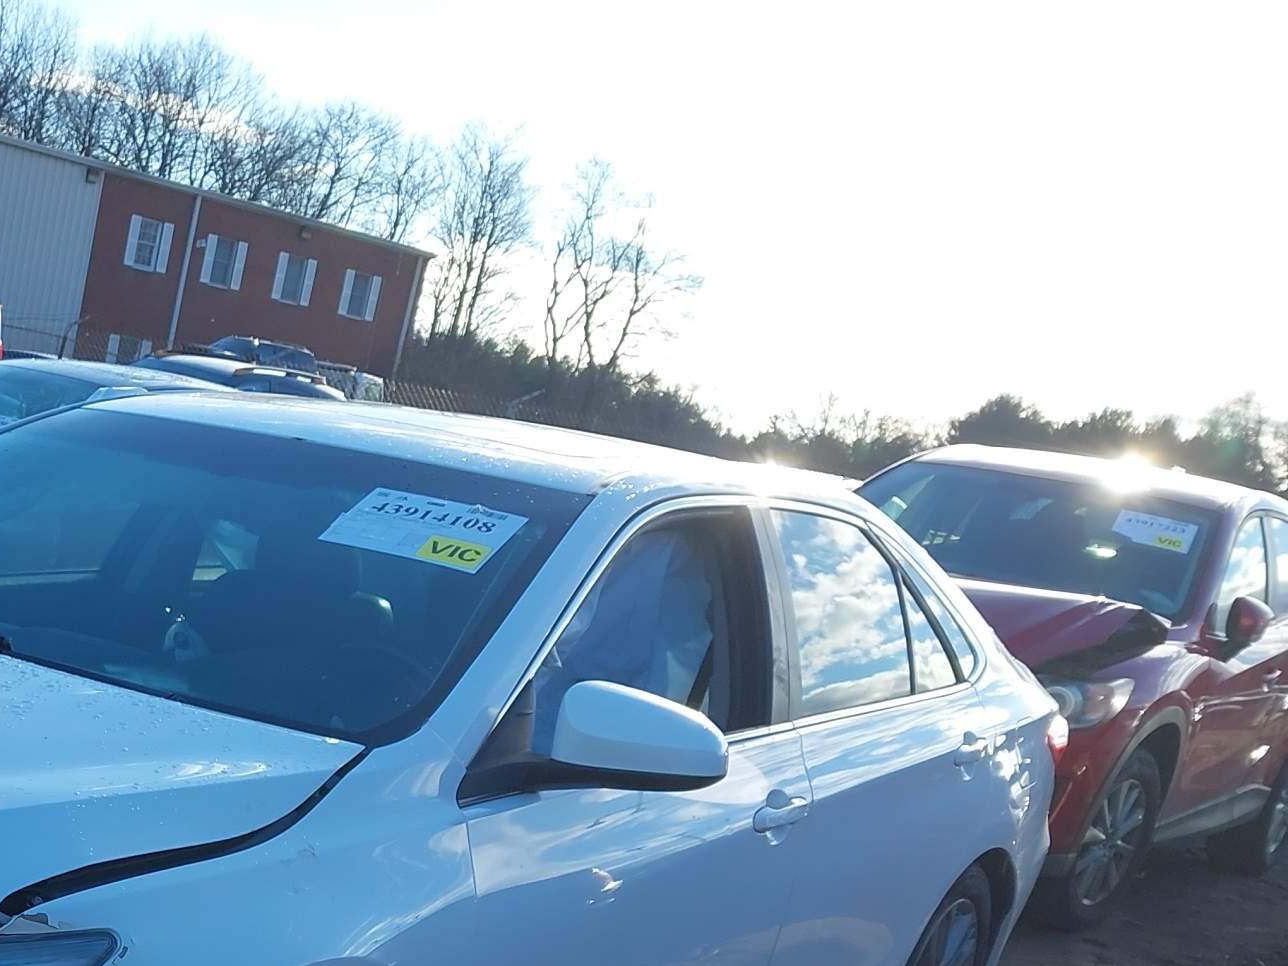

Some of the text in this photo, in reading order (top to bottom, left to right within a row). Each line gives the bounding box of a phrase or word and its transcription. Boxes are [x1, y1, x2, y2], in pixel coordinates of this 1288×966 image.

[372, 503, 496, 533] 43914108
[430, 540, 482, 562] VIC
[1158, 536, 1183, 548] VIC
